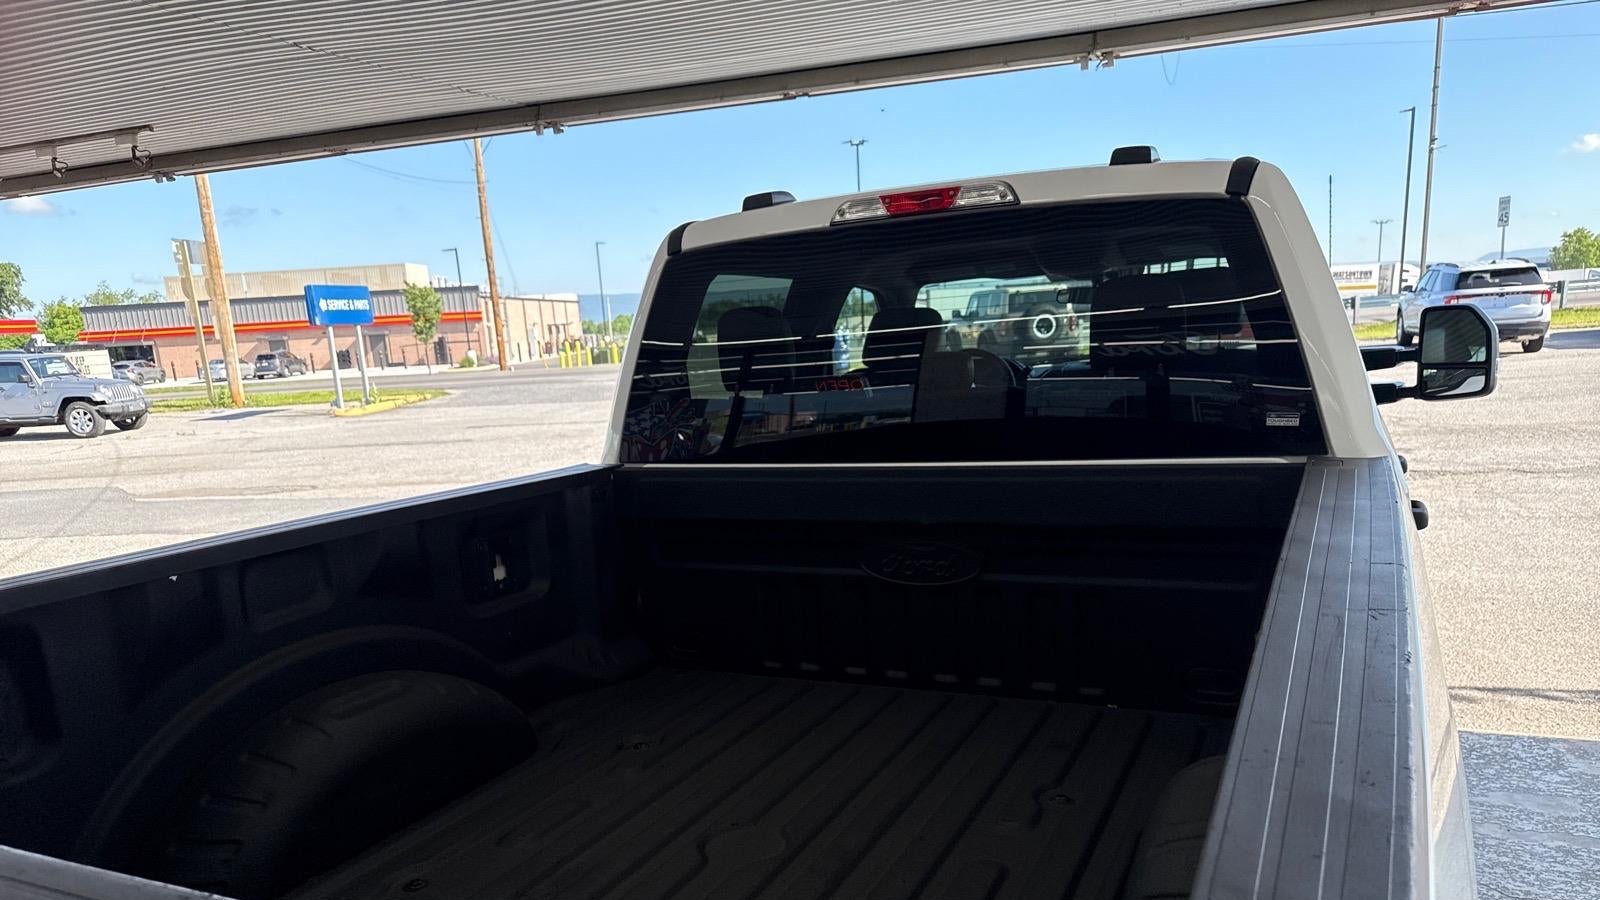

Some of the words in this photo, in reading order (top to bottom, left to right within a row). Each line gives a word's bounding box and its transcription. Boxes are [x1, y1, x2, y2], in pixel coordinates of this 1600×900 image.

[1499, 212, 1509, 223] 45
[327, 299, 350, 311] SERVICE
[354, 299, 370, 311] PARTS
[880, 548, 958, 577] Ford
